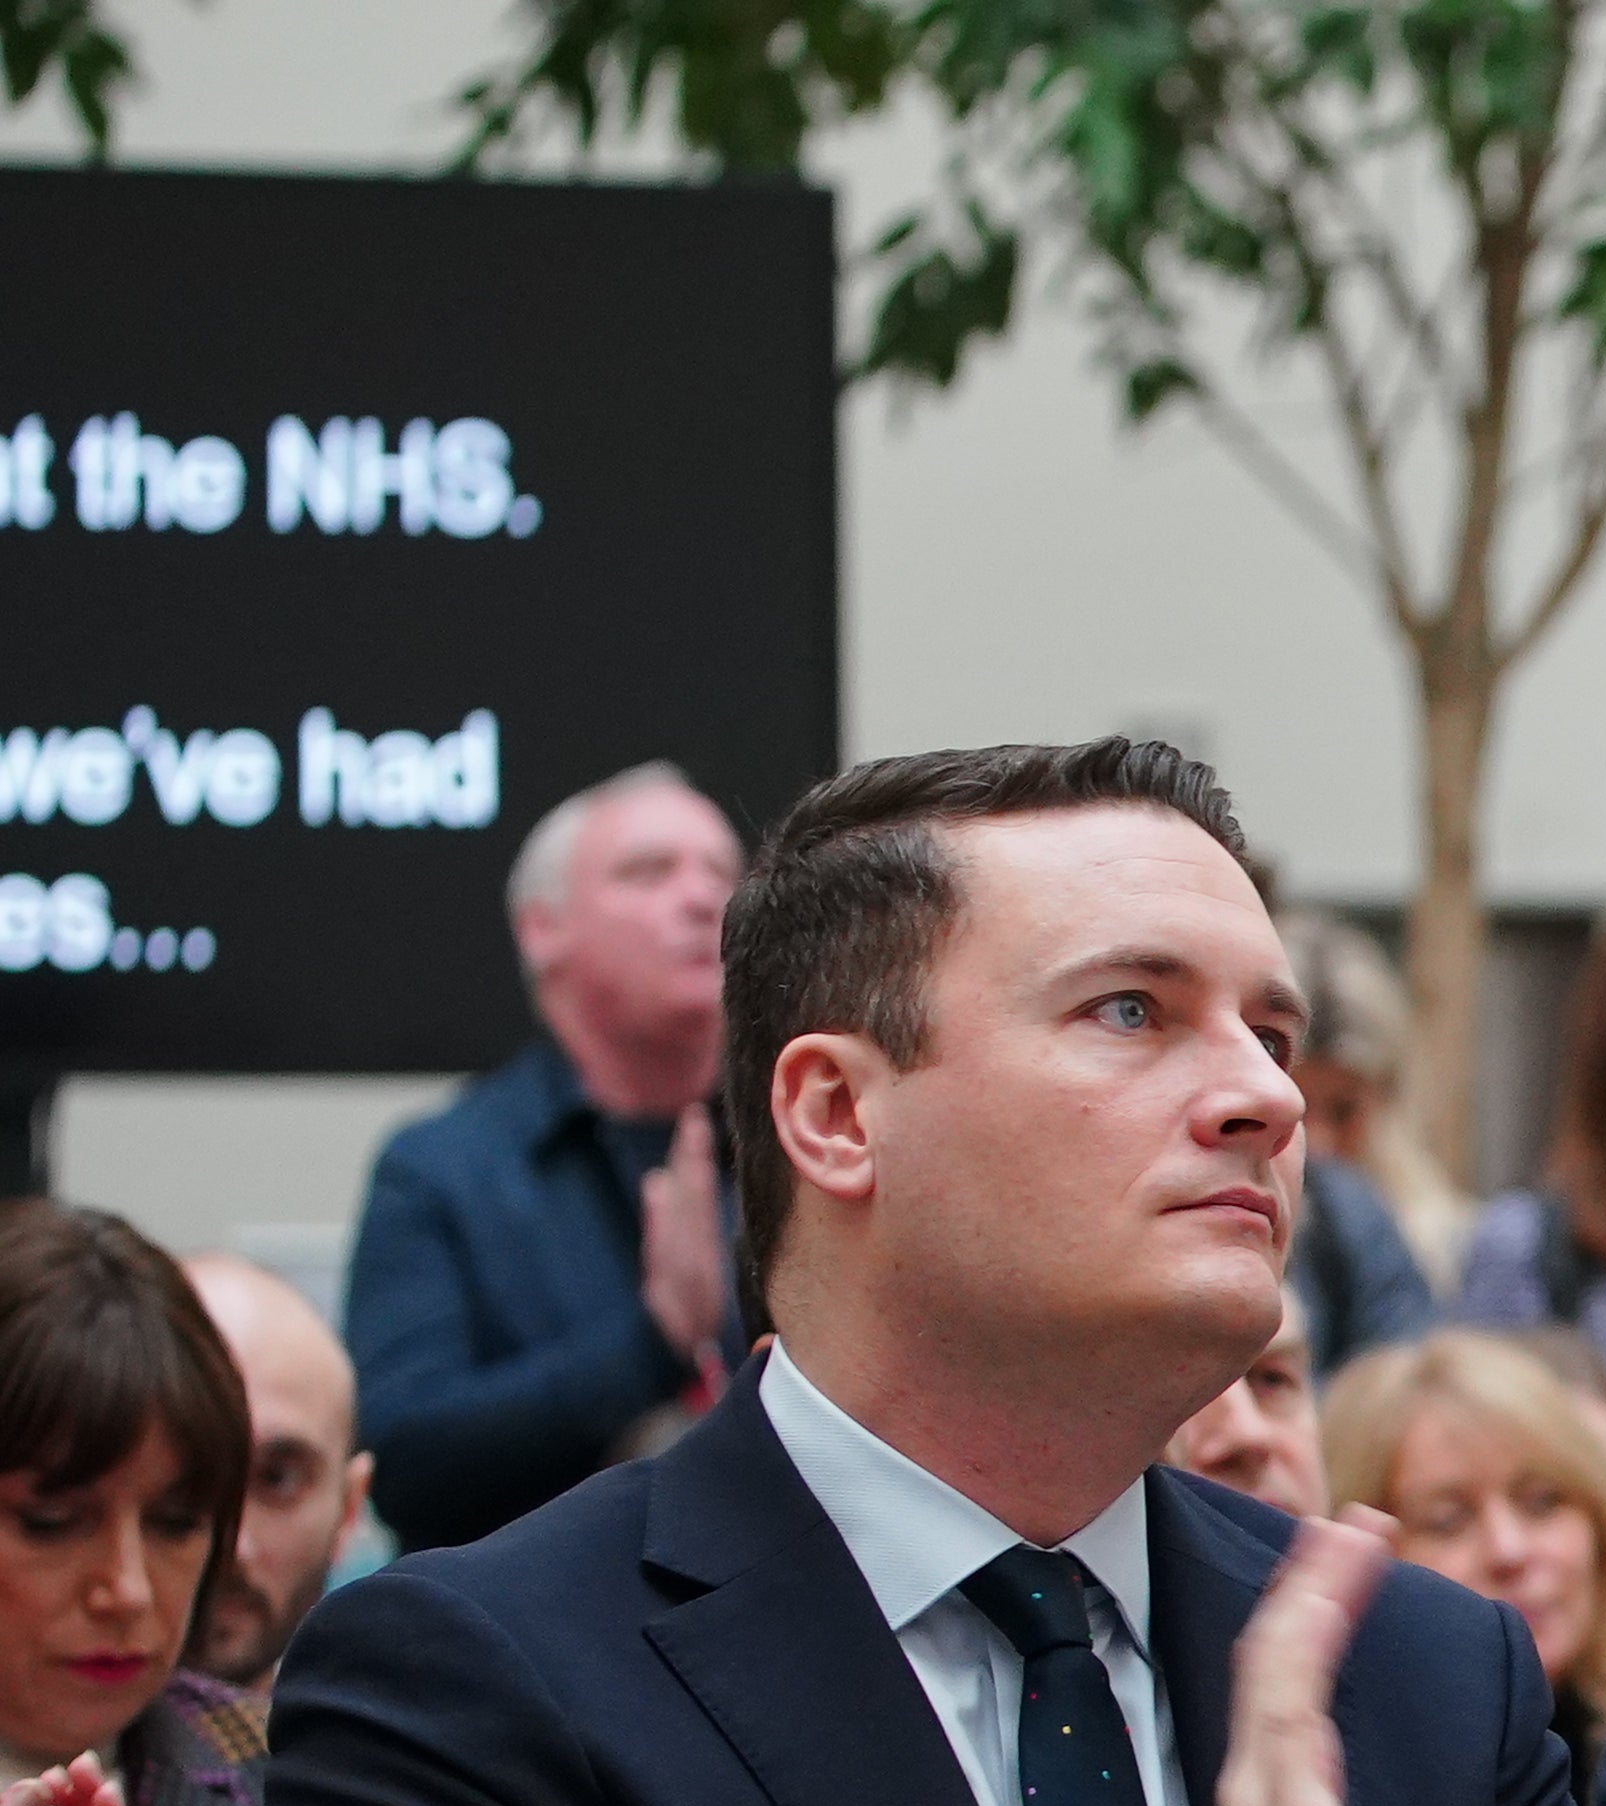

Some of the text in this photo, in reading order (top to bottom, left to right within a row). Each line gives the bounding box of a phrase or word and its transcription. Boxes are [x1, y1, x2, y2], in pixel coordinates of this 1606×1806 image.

[0, 412, 542, 538] t the NHS.
[0, 705, 500, 828] we've had
